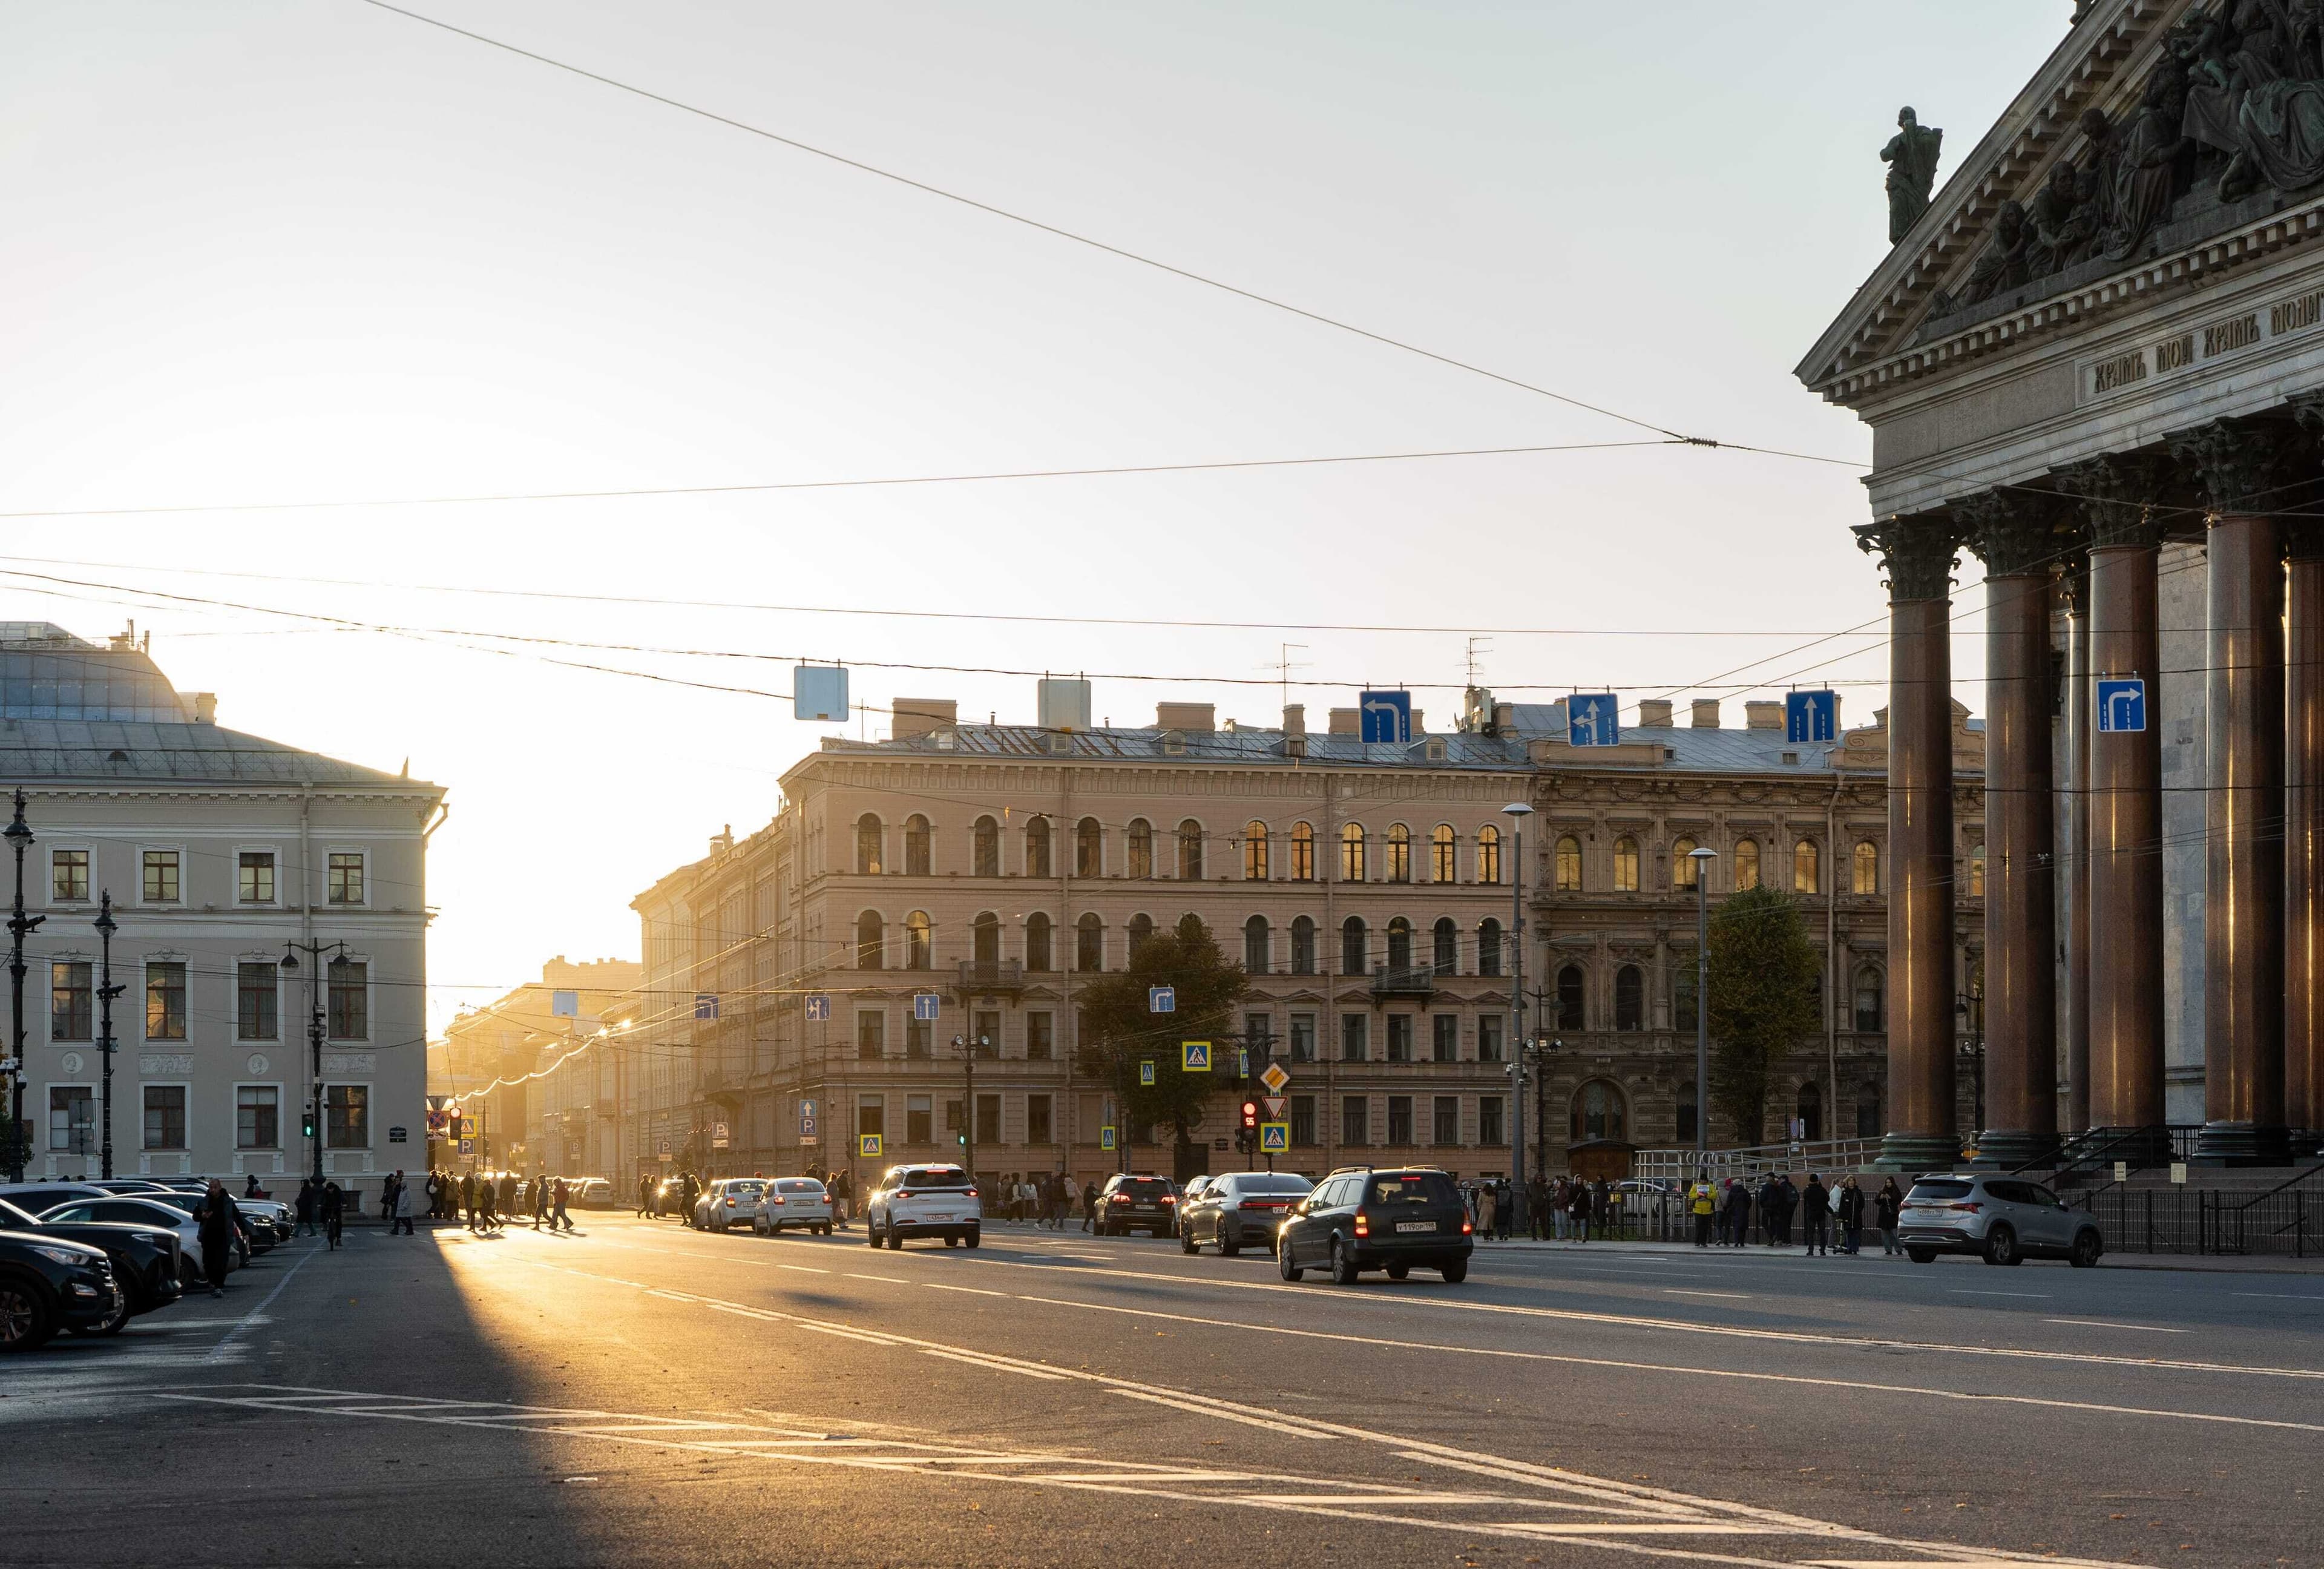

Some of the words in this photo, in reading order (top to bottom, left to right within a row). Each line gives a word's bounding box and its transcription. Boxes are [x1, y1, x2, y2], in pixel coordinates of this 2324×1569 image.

[2271, 292, 2324, 335] МОЛИ
[804, 1119, 813, 1133] P
[1246, 1117, 1255, 1126] 55
[717, 1123, 725, 1136] P
[462, 1140, 471, 1153] P
[663, 1142, 669, 1153] P
